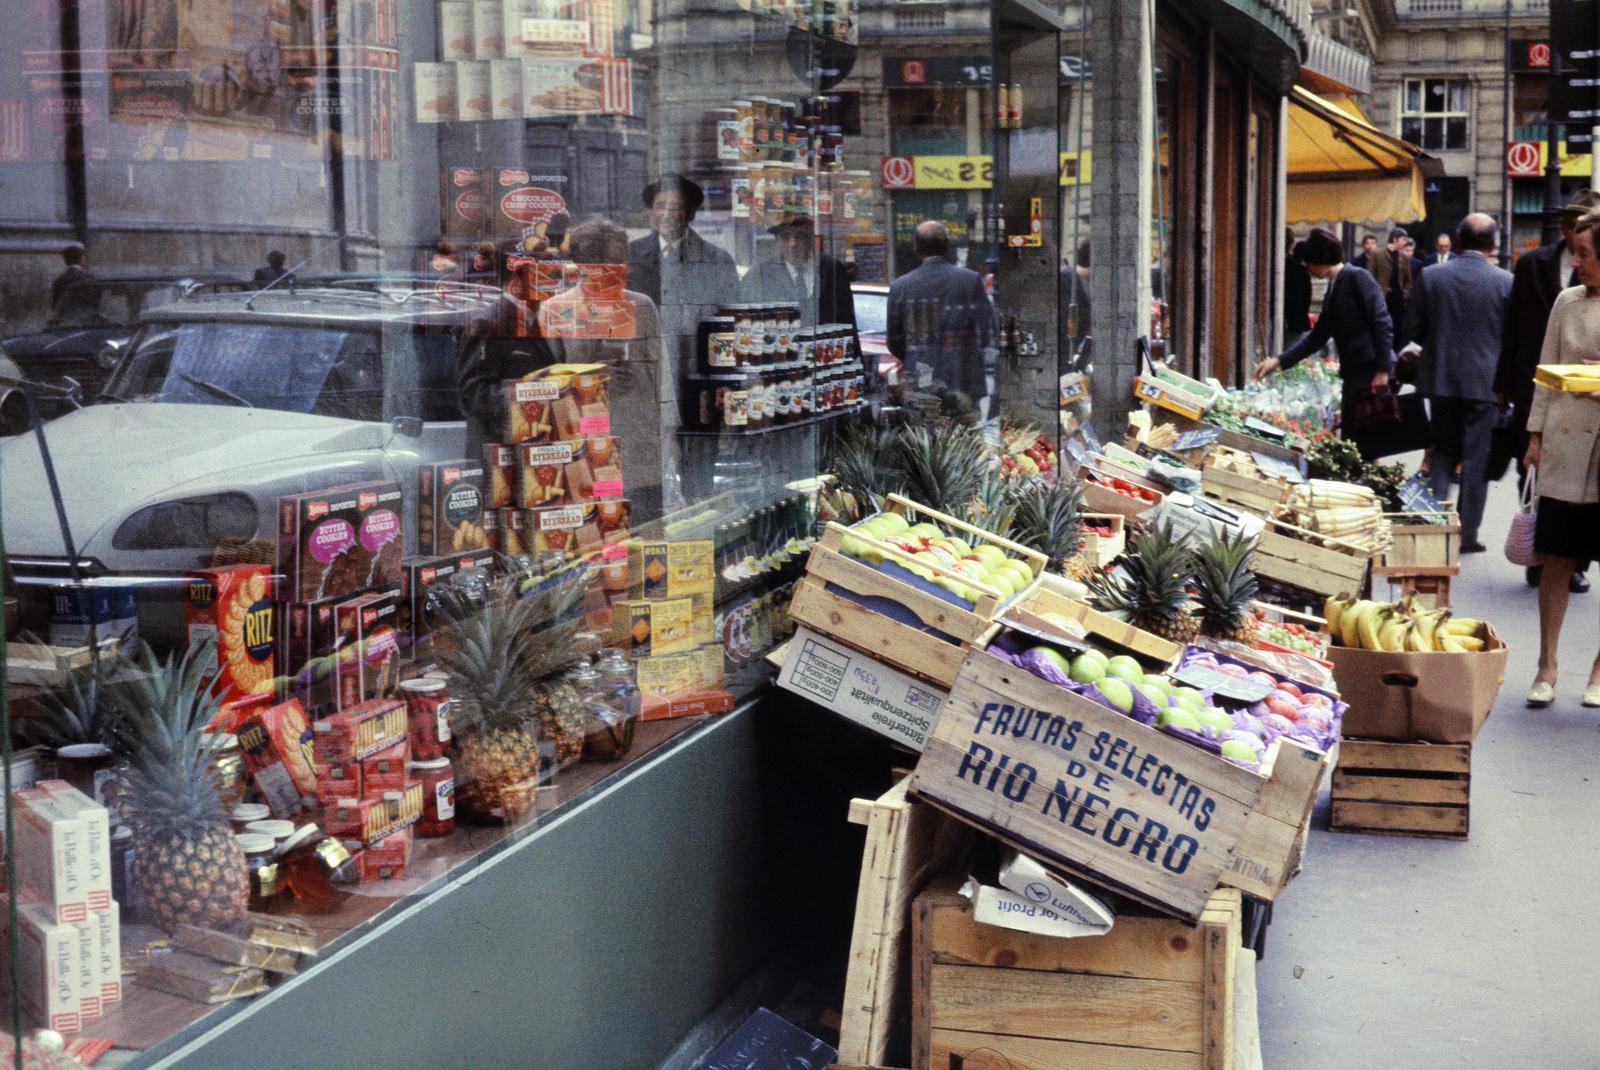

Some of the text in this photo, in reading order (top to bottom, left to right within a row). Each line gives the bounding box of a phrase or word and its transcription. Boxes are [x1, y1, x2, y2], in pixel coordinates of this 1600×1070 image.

[531, 174, 568, 183] IMPORTED
[449, 498, 478, 510] COOKIES
[452, 490, 477, 500] BUTTER
[365, 520, 394, 533] COOKIES
[368, 511, 393, 524] BUTTER
[319, 522, 347, 535] BUTTER
[316, 531, 348, 545] COOKIES
[190, 583, 212, 601] RITZ
[245, 607, 273, 648] RITZ
[850, 686, 931, 732] Spitzenqualität
[871, 710, 924, 745] Bitterfreie
[238, 725, 266, 751] RITZ
[974, 702, 1217, 832] FRUTAS SELECTAS
[1066, 759, 1112, 793] DE
[956, 740, 1200, 876] RIO NEGRO
[998, 899, 1037, 917] Profit
